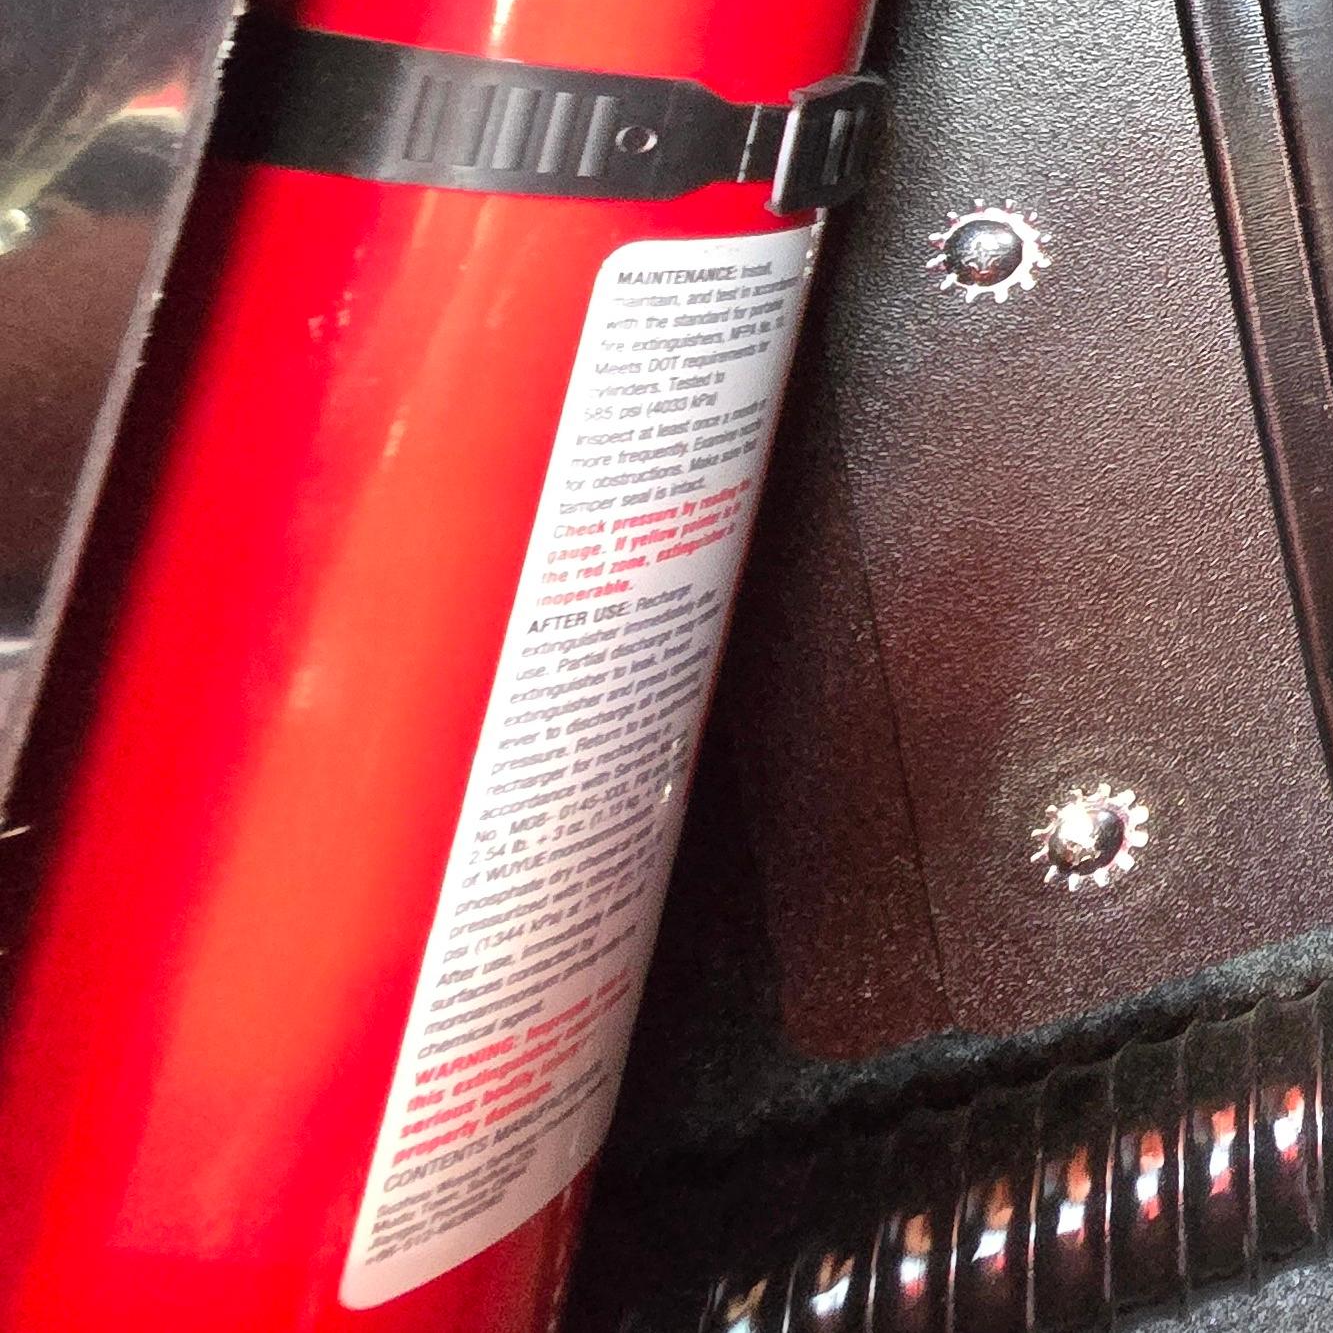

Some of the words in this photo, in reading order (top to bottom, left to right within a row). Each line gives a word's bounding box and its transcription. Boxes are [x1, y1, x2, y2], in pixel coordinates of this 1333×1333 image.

[647, 355, 680, 372] DOT
[669, 372, 712, 390] Tested
[553, 519, 607, 539] Check
[547, 543, 607, 565] gauge.
[576, 562, 605, 580] red
[526, 611, 588, 635] AFTER
